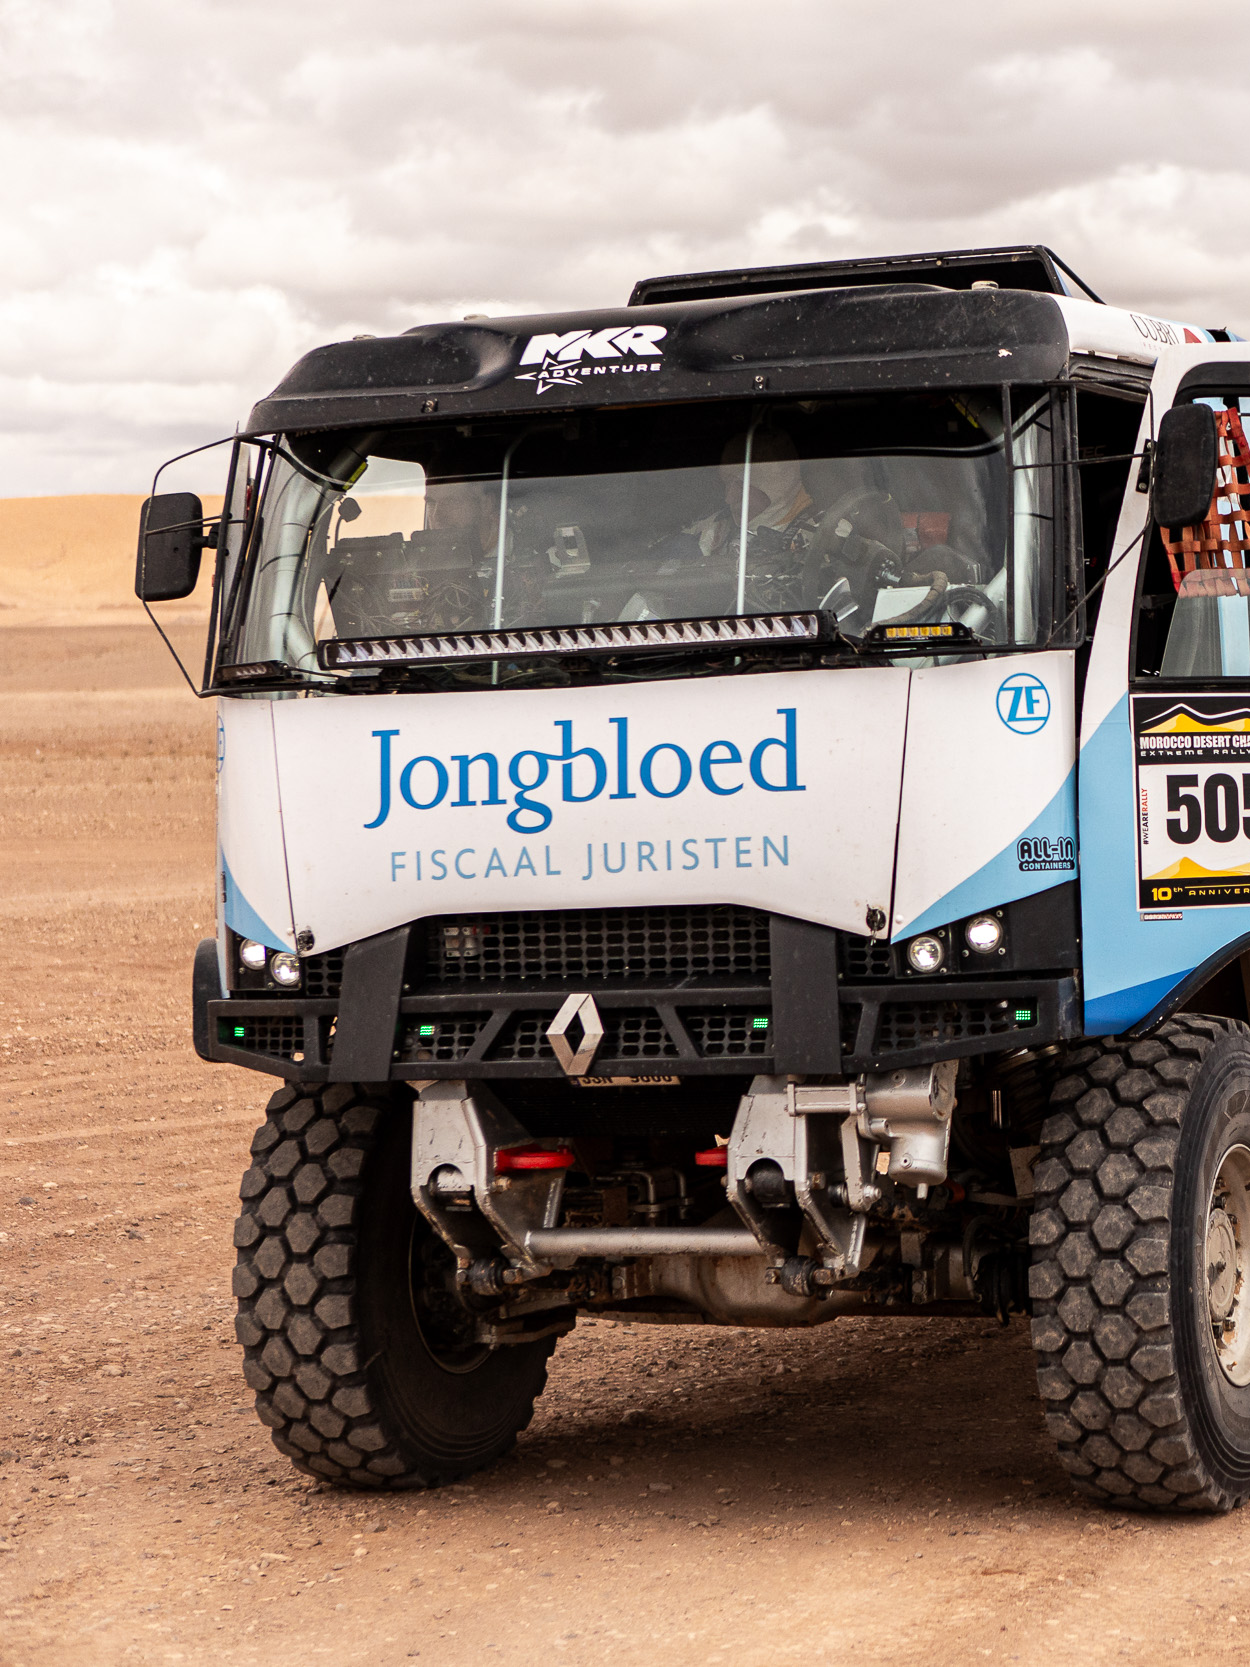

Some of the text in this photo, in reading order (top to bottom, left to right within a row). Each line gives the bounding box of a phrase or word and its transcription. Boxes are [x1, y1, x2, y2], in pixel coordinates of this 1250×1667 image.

[519, 325, 667, 365] MKR
[538, 363, 661, 379] ADVENTURE
[998, 683, 1049, 725] ZF
[1140, 736, 1191, 749] MOROCCO
[1193, 735, 1231, 748] DESERT
[363, 708, 806, 834] Jongbloed
[1141, 788, 1149, 845] #WEARERALLY
[391, 835, 790, 882] FISCAAL JURISTEN
[1018, 837, 1075, 862] ALL-IN
[1021, 862, 1072, 870] CONTAINERS
